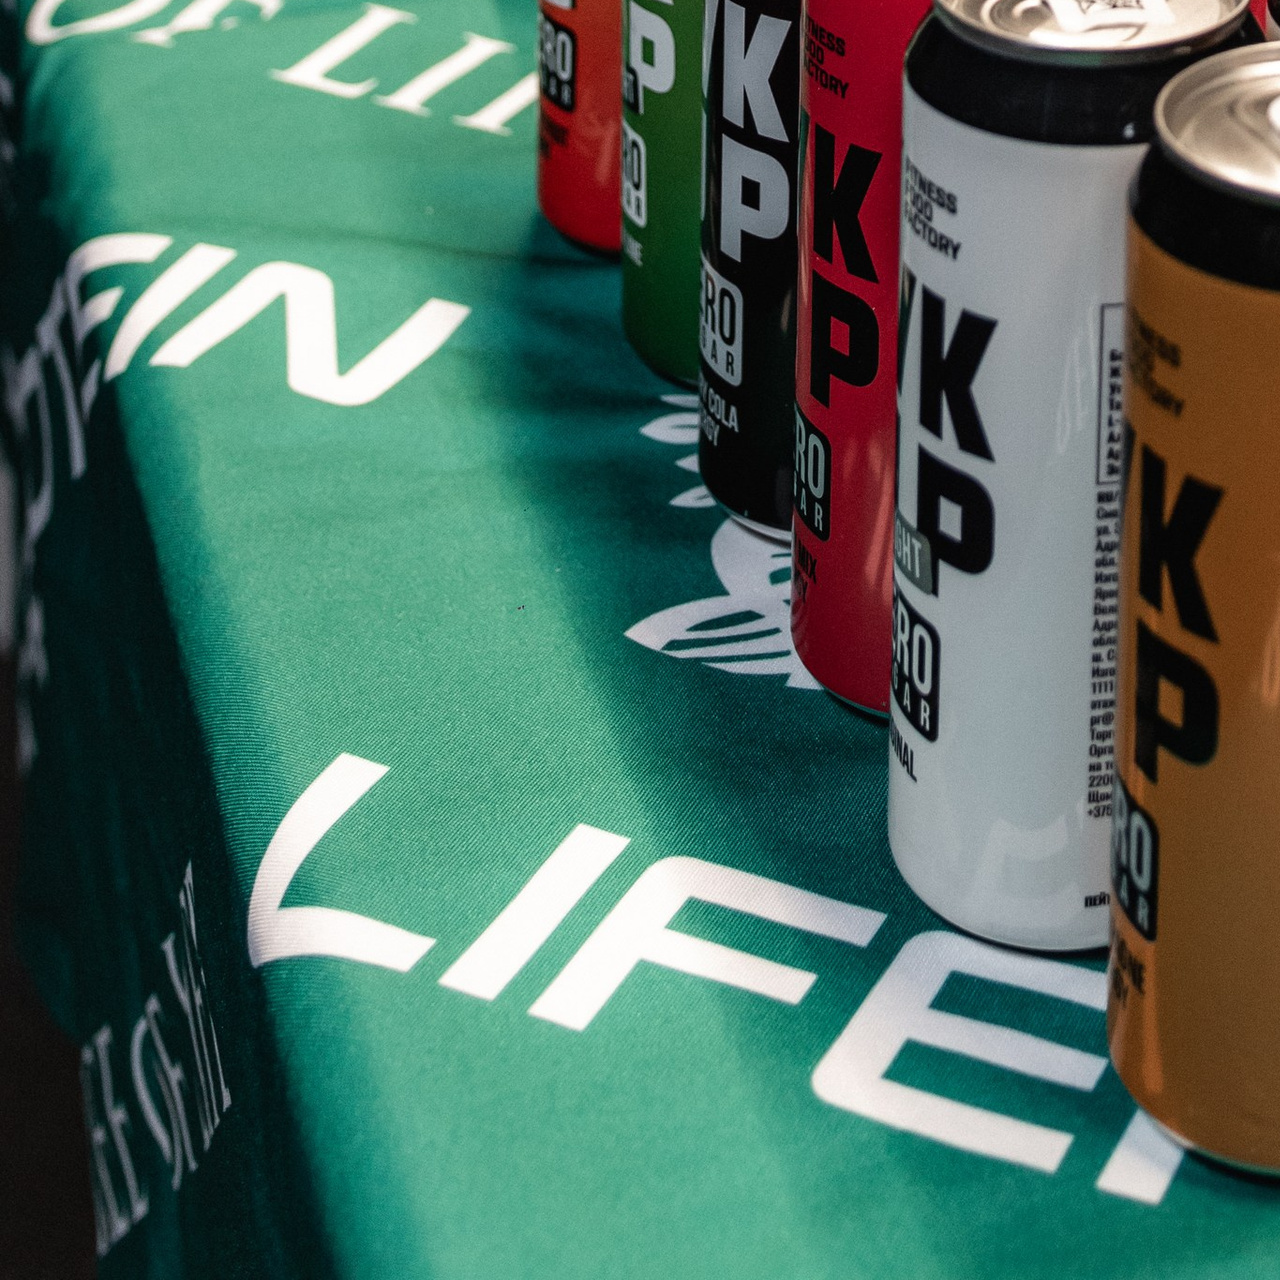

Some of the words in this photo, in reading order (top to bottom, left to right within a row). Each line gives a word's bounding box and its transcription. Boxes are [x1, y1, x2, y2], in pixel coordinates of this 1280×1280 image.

[720, 132, 790, 264] P
[816, 124, 883, 284] K
[701, 268, 737, 348] RO
[811, 268, 880, 409] P
[709, 387, 739, 433] COLA
[917, 442, 996, 597] P
[1139, 443, 1226, 646] K
[893, 595, 932, 696] RO
[1091, 667, 1116, 679] Изго
[1091, 682, 1114, 695] 1111
[1090, 711, 1114, 729] pr@
[1090, 728, 1113, 743] Торг
[1136, 619, 1220, 785] P
[1087, 806, 1112, 819] +375
